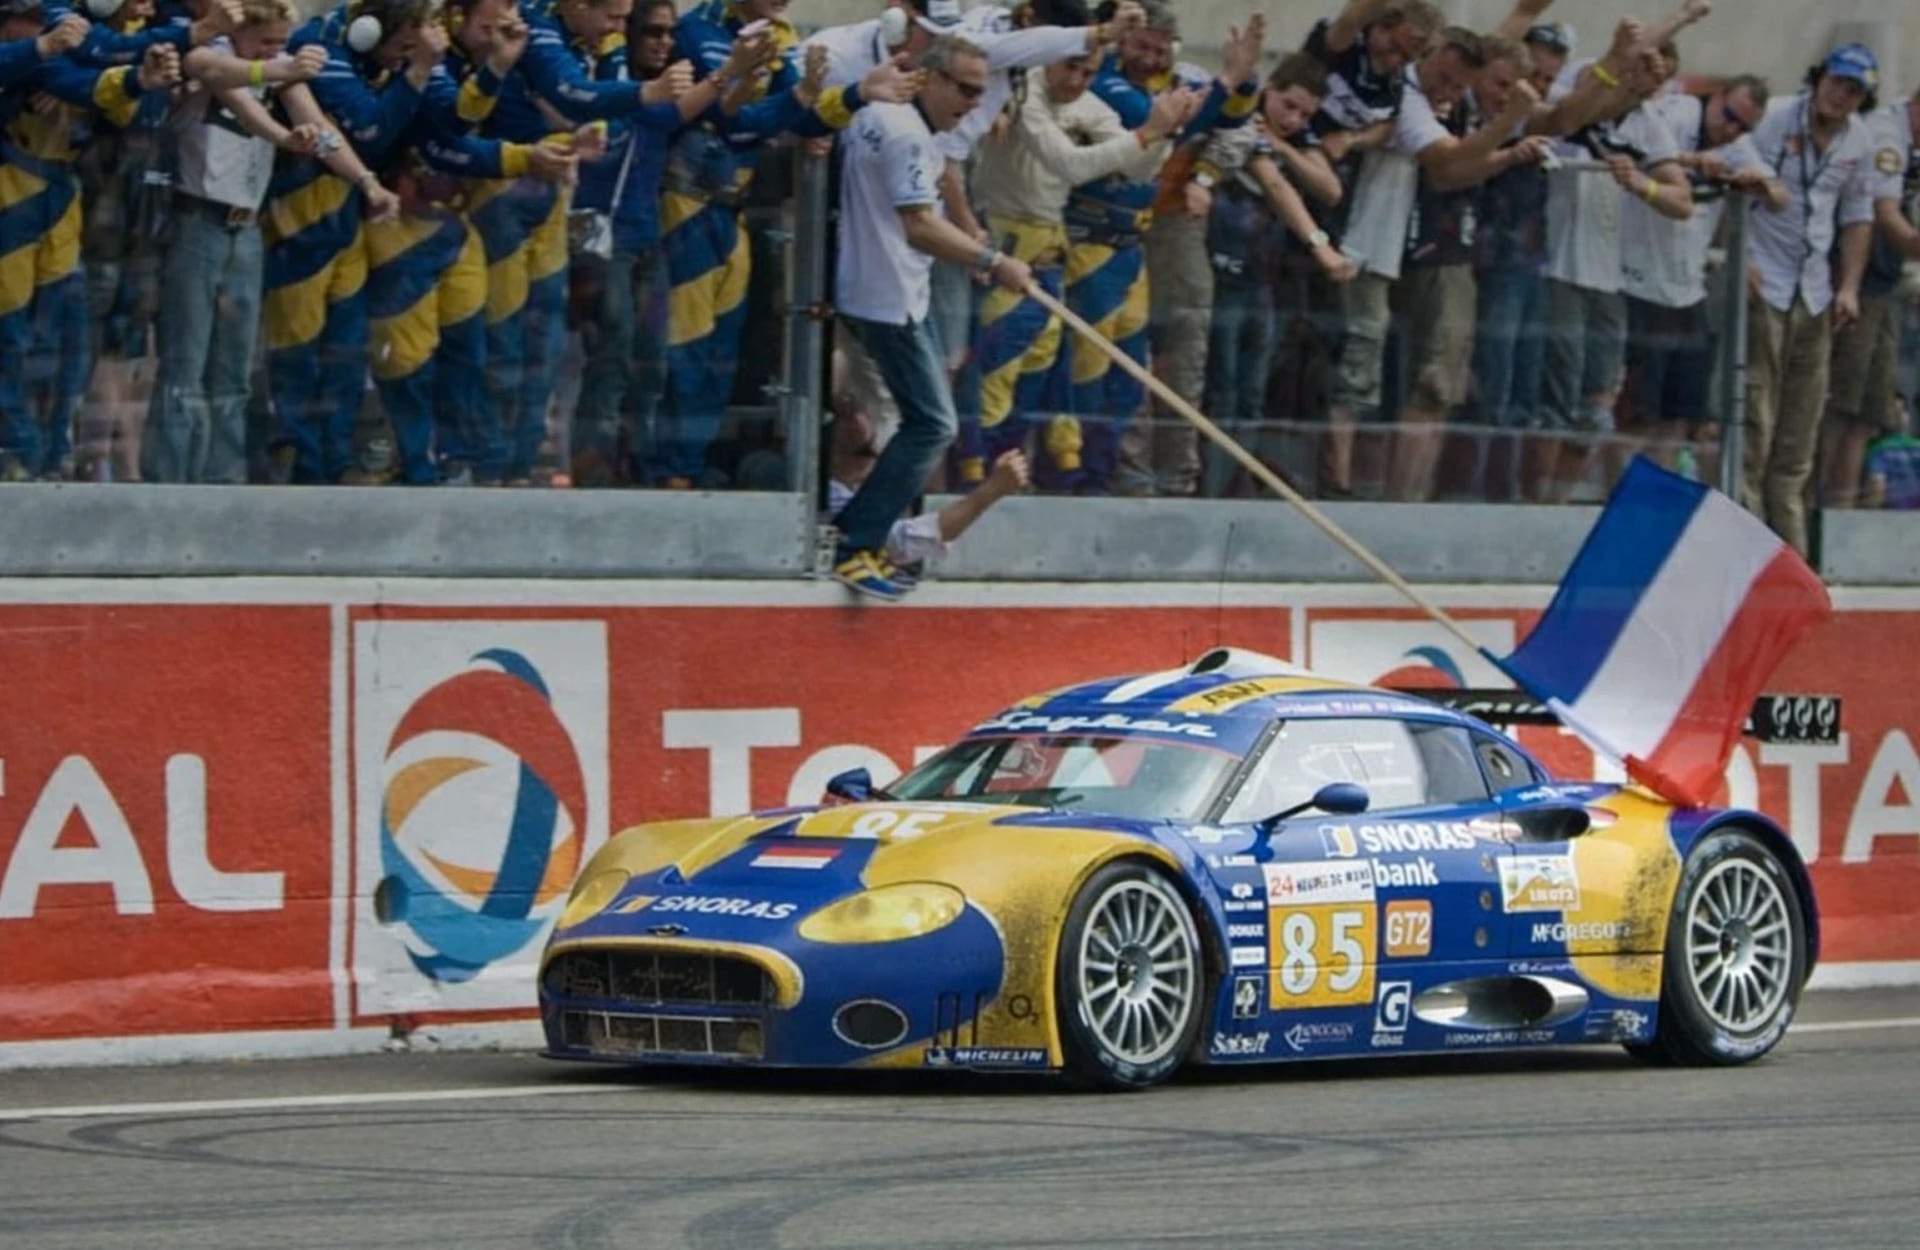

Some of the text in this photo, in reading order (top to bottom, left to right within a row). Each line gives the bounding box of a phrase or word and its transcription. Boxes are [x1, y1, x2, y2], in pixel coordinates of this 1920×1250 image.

[1359, 822, 1476, 854] SNORAS
[1270, 876, 1294, 897] 24
[1374, 857, 1439, 887] bank
[652, 896, 798, 919] SNORAS
[1386, 911, 1431, 947] GT2
[1281, 911, 1364, 995] 85
[954, 1050, 1044, 1062] MICHELIN
